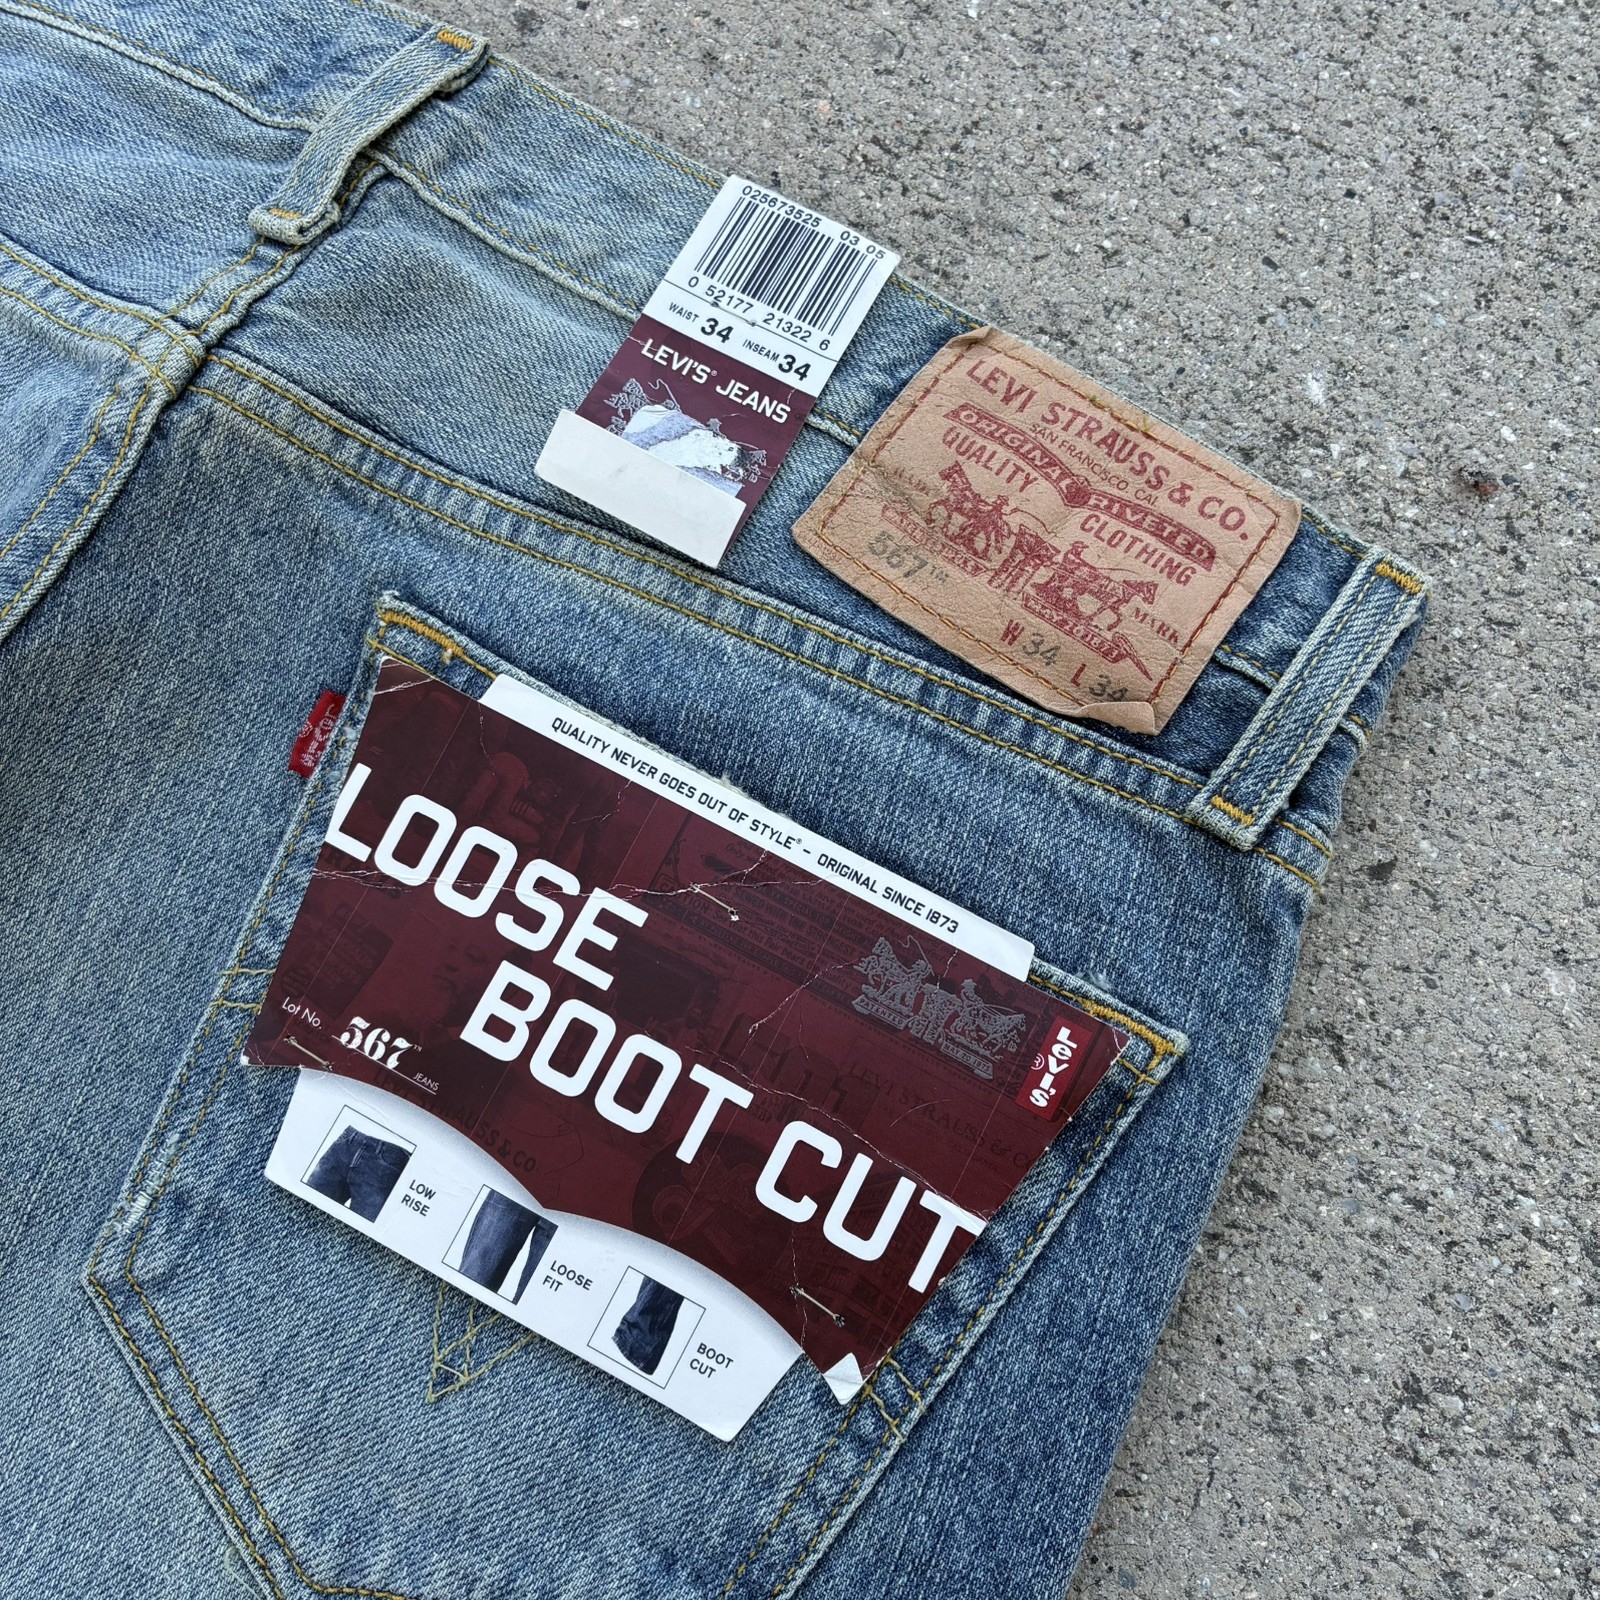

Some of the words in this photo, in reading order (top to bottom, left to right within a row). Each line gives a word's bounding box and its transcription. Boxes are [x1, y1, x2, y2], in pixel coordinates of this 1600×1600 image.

[741, 185, 823, 228] 025673525
[839, 230, 860, 246] 03
[865, 244, 886, 260] 05
[668, 302, 698, 323] WAIST
[700, 316, 734, 344] 34
[742, 340, 779, 362] INSEAM
[778, 354, 811, 382] 34
[687, 276, 700, 288] 0
[704, 284, 754, 314] 52177
[762, 312, 812, 343] 21322
[818, 338, 831, 351] 6
[715, 379, 791, 424] JEANS
[1027, 420, 1059, 445] SAN
[941, 424, 1043, 493] QUALITY
[965, 358, 1039, 414] LEVI
[1043, 401, 1172, 490] STRAUSS
[1167, 480, 1194, 508] &
[1197, 495, 1249, 541] CO.
[957, 407, 1074, 493] ORIGINAL
[1086, 493, 1211, 562] RIVETED
[1079, 513, 1197, 587] CLOTHING
[999, 618, 1025, 647] W
[1021, 631, 1063, 667] 34
[1069, 662, 1087, 688] L
[1024, 597, 1064, 625] MAY
[1082, 631, 1120, 660] 1873
[551, 717, 611, 754] QUALITY
[610, 747, 659, 780] NEVER
[658, 772, 697, 799] GOES
[697, 792, 728, 814] OUT
[727, 807, 750, 824] OF
[817, 853, 878, 894] ORIGINAL
[881, 886, 926, 917] SINCE
[925, 908, 959, 934] 1873
[323, 762, 650, 992] LOOSE
[281, 996, 302, 1015] Lot
[299, 1006, 326, 1032] No.
[857, 996, 905, 1027] PATENTED
[942, 1042, 961, 1057] MAY
[959, 1051, 973, 1063] 20
[413, 1072, 440, 1091] JEANS
[459, 959, 755, 1165] BOOT
[754, 1120, 989, 1294] CUT
[400, 1191, 434, 1217] RISE
[405, 1179, 437, 1205] LOW
[542, 1272, 566, 1292] FIT
[547, 1259, 593, 1292] LOOSE
[689, 1355, 721, 1379] CUT
[693, 1342, 734, 1374] BOOT
